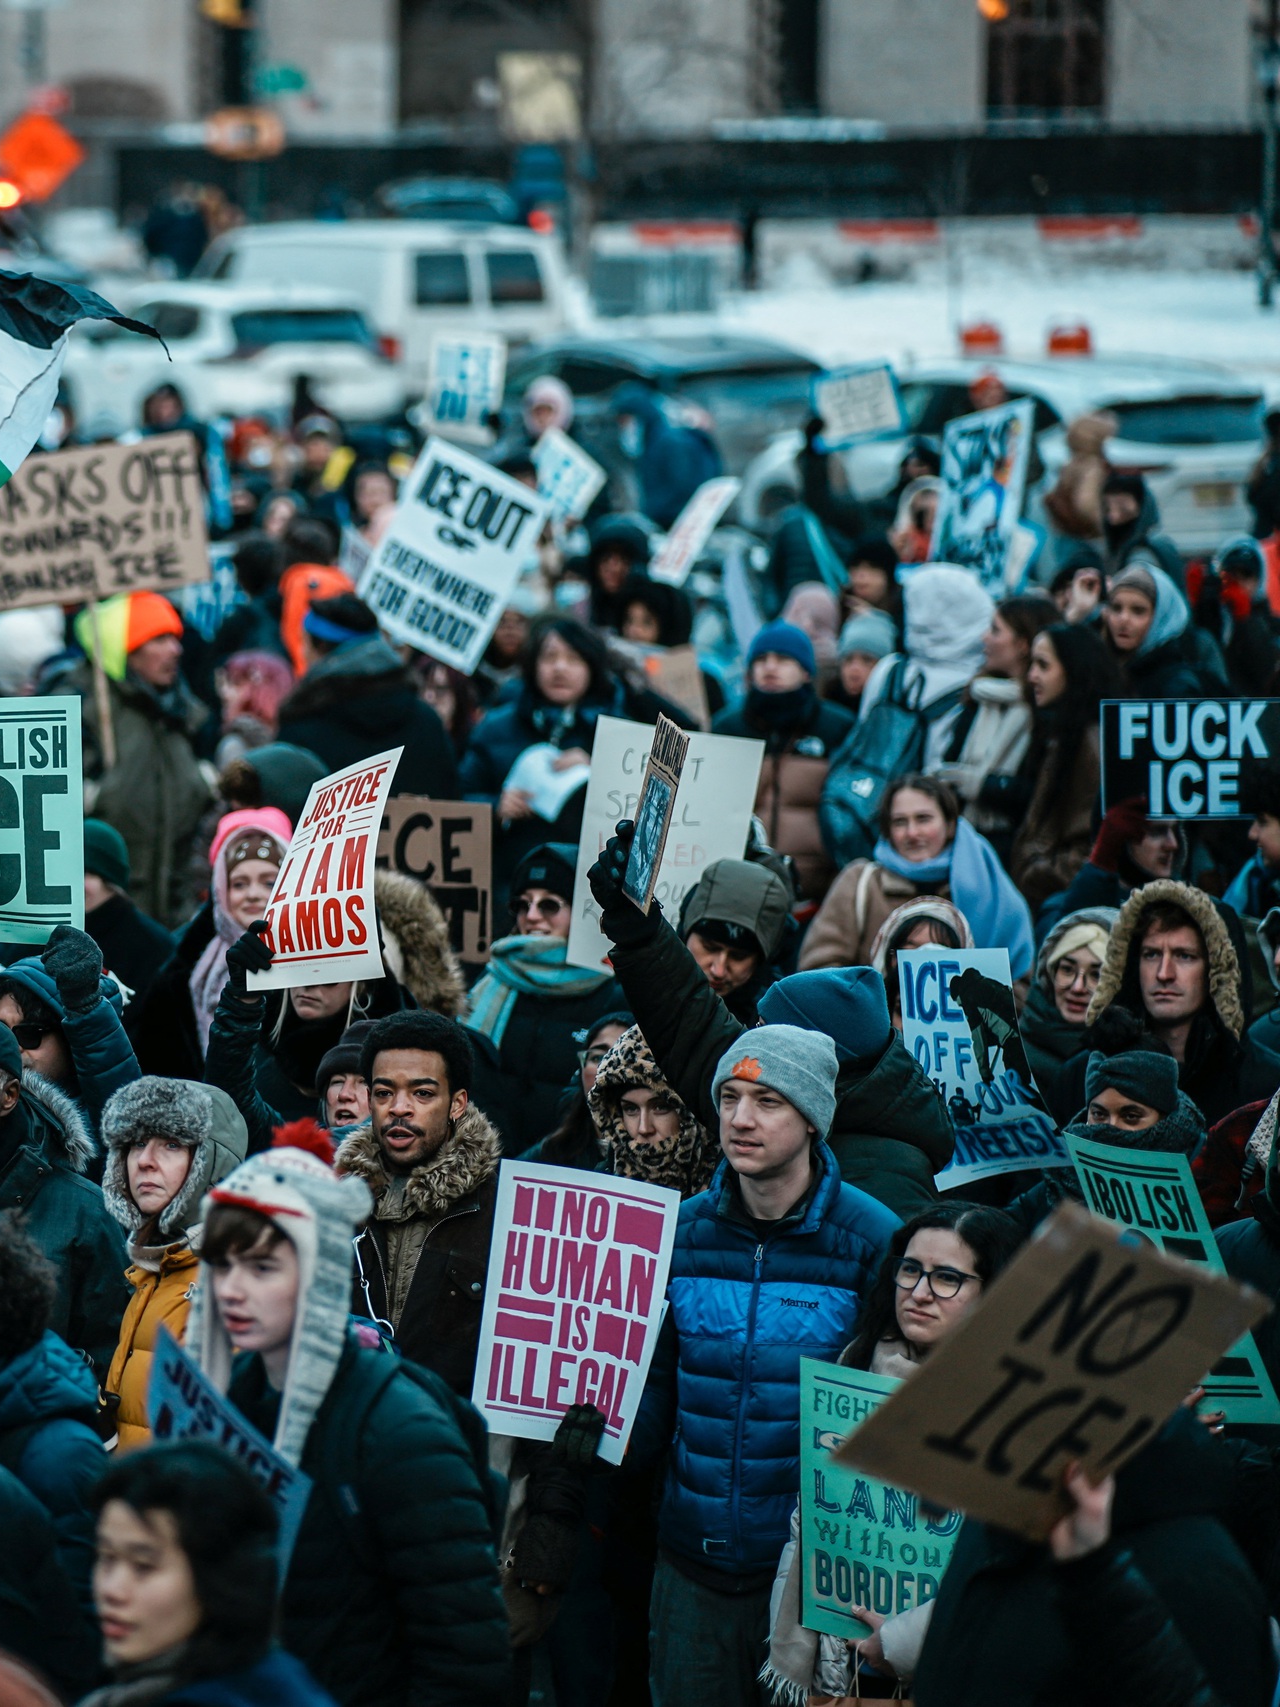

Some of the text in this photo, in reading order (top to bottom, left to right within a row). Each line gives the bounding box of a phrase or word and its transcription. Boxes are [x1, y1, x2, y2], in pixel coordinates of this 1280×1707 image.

[120, 450, 193, 507] OFF
[418, 460, 471, 519] ICE
[462, 486, 534, 550] OUT
[110, 543, 181, 585] ICE
[436, 524, 478, 550] OF
[370, 572, 407, 615] FOR
[381, 540, 496, 618] EVERYWHERE
[1119, 700, 1269, 760] FUCK
[302, 767, 388, 829] JUSTICE
[1149, 760, 1240, 818] ICE
[311, 814, 346, 844] FOR
[271, 833, 369, 905] LIAM
[259, 894, 367, 955] RAMOS
[903, 960, 965, 1024] ICE
[914, 1032, 971, 1081] OFF
[975, 1068, 1035, 1115] OUR
[559, 1190, 610, 1242] NO
[1084, 1169, 1199, 1233] ABOLISH
[501, 1230, 657, 1318] HUMAN
[780, 1298, 820, 1309] Marmot
[557, 1303, 591, 1352] IS
[1017, 1250, 1194, 1375] NO
[486, 1342, 629, 1430] ILLEGAL
[163, 1357, 295, 1505] JUSTICE
[815, 1548, 939, 1615] BORDER
